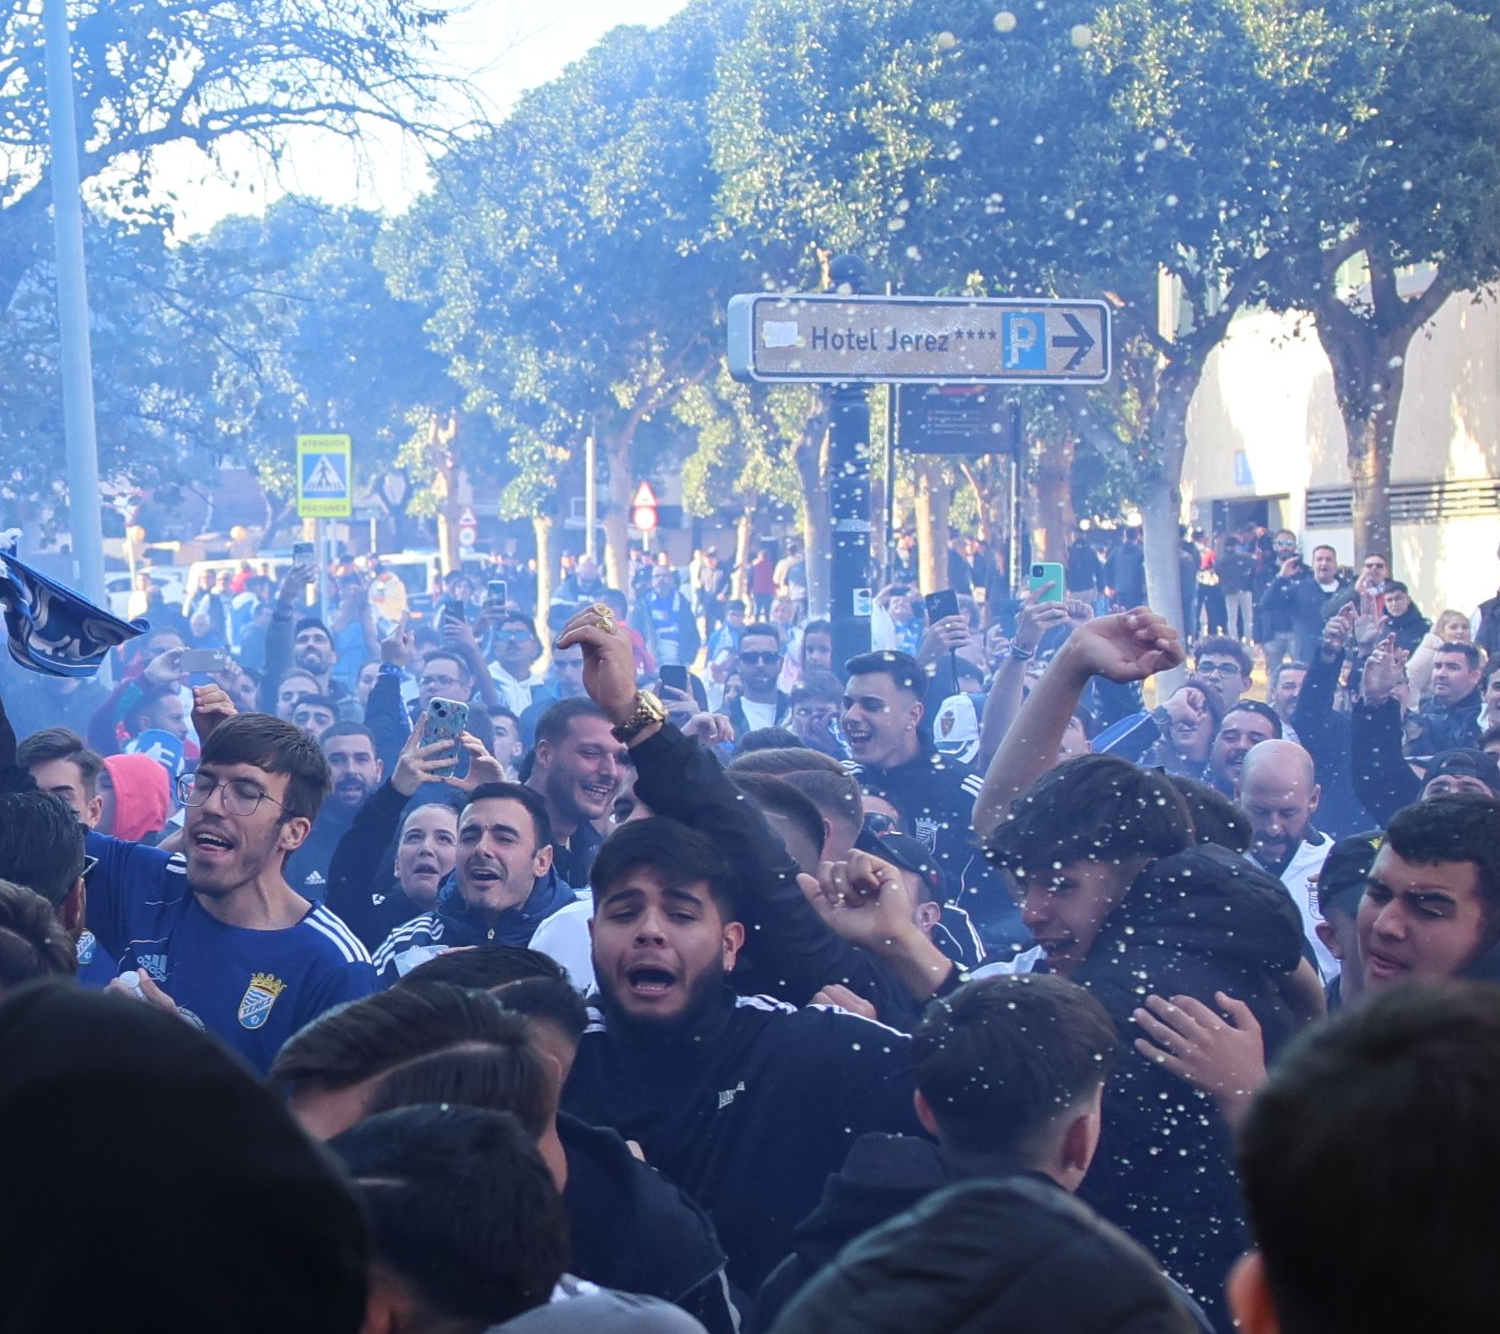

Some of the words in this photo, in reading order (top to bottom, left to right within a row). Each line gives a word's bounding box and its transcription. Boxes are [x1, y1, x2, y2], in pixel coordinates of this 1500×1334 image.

[811, 326, 877, 352] Hotel
[887, 327, 949, 353] Jerez
[1009, 317, 1037, 364] P
